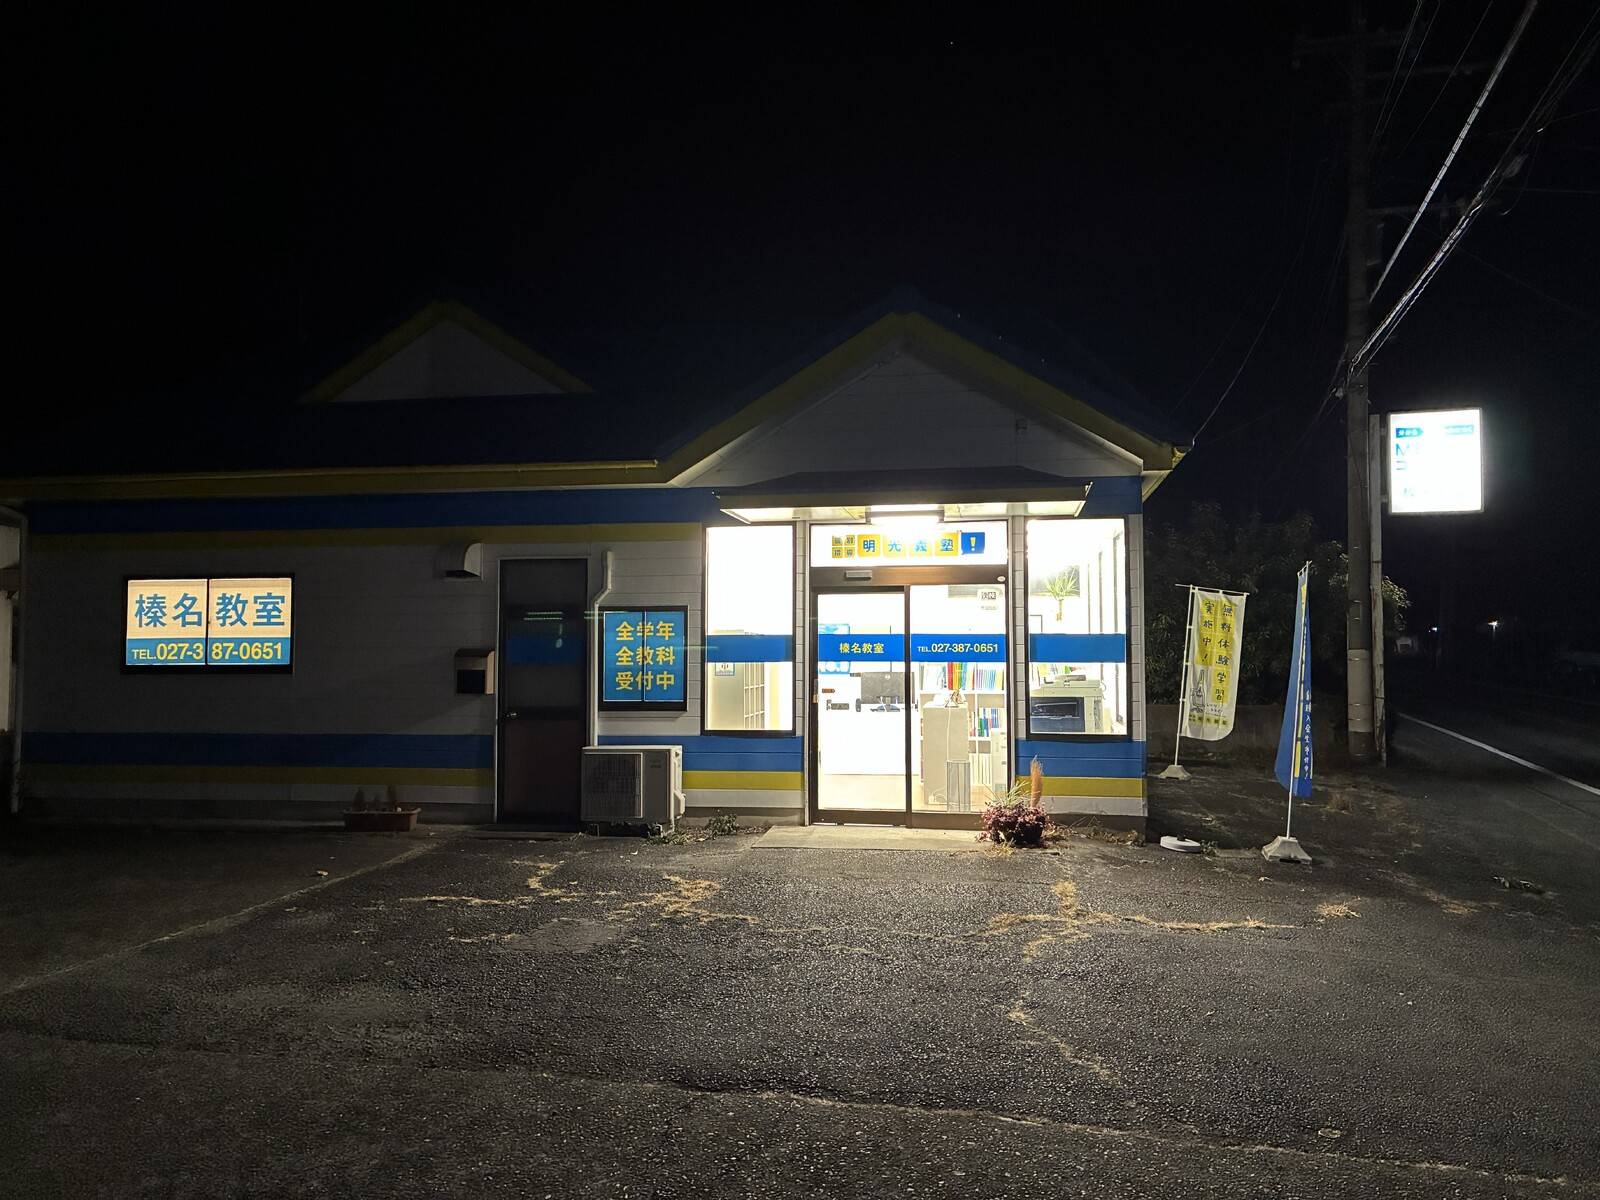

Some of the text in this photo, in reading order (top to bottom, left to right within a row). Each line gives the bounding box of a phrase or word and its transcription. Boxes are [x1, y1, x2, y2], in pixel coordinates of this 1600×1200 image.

[134, 592, 286, 627] 榛名教室
[615, 621, 676, 641] 全学年
[615, 645, 676, 666] 全教科
[839, 642, 885, 654] 榛名教室
[615, 670, 676, 691] 受付中
